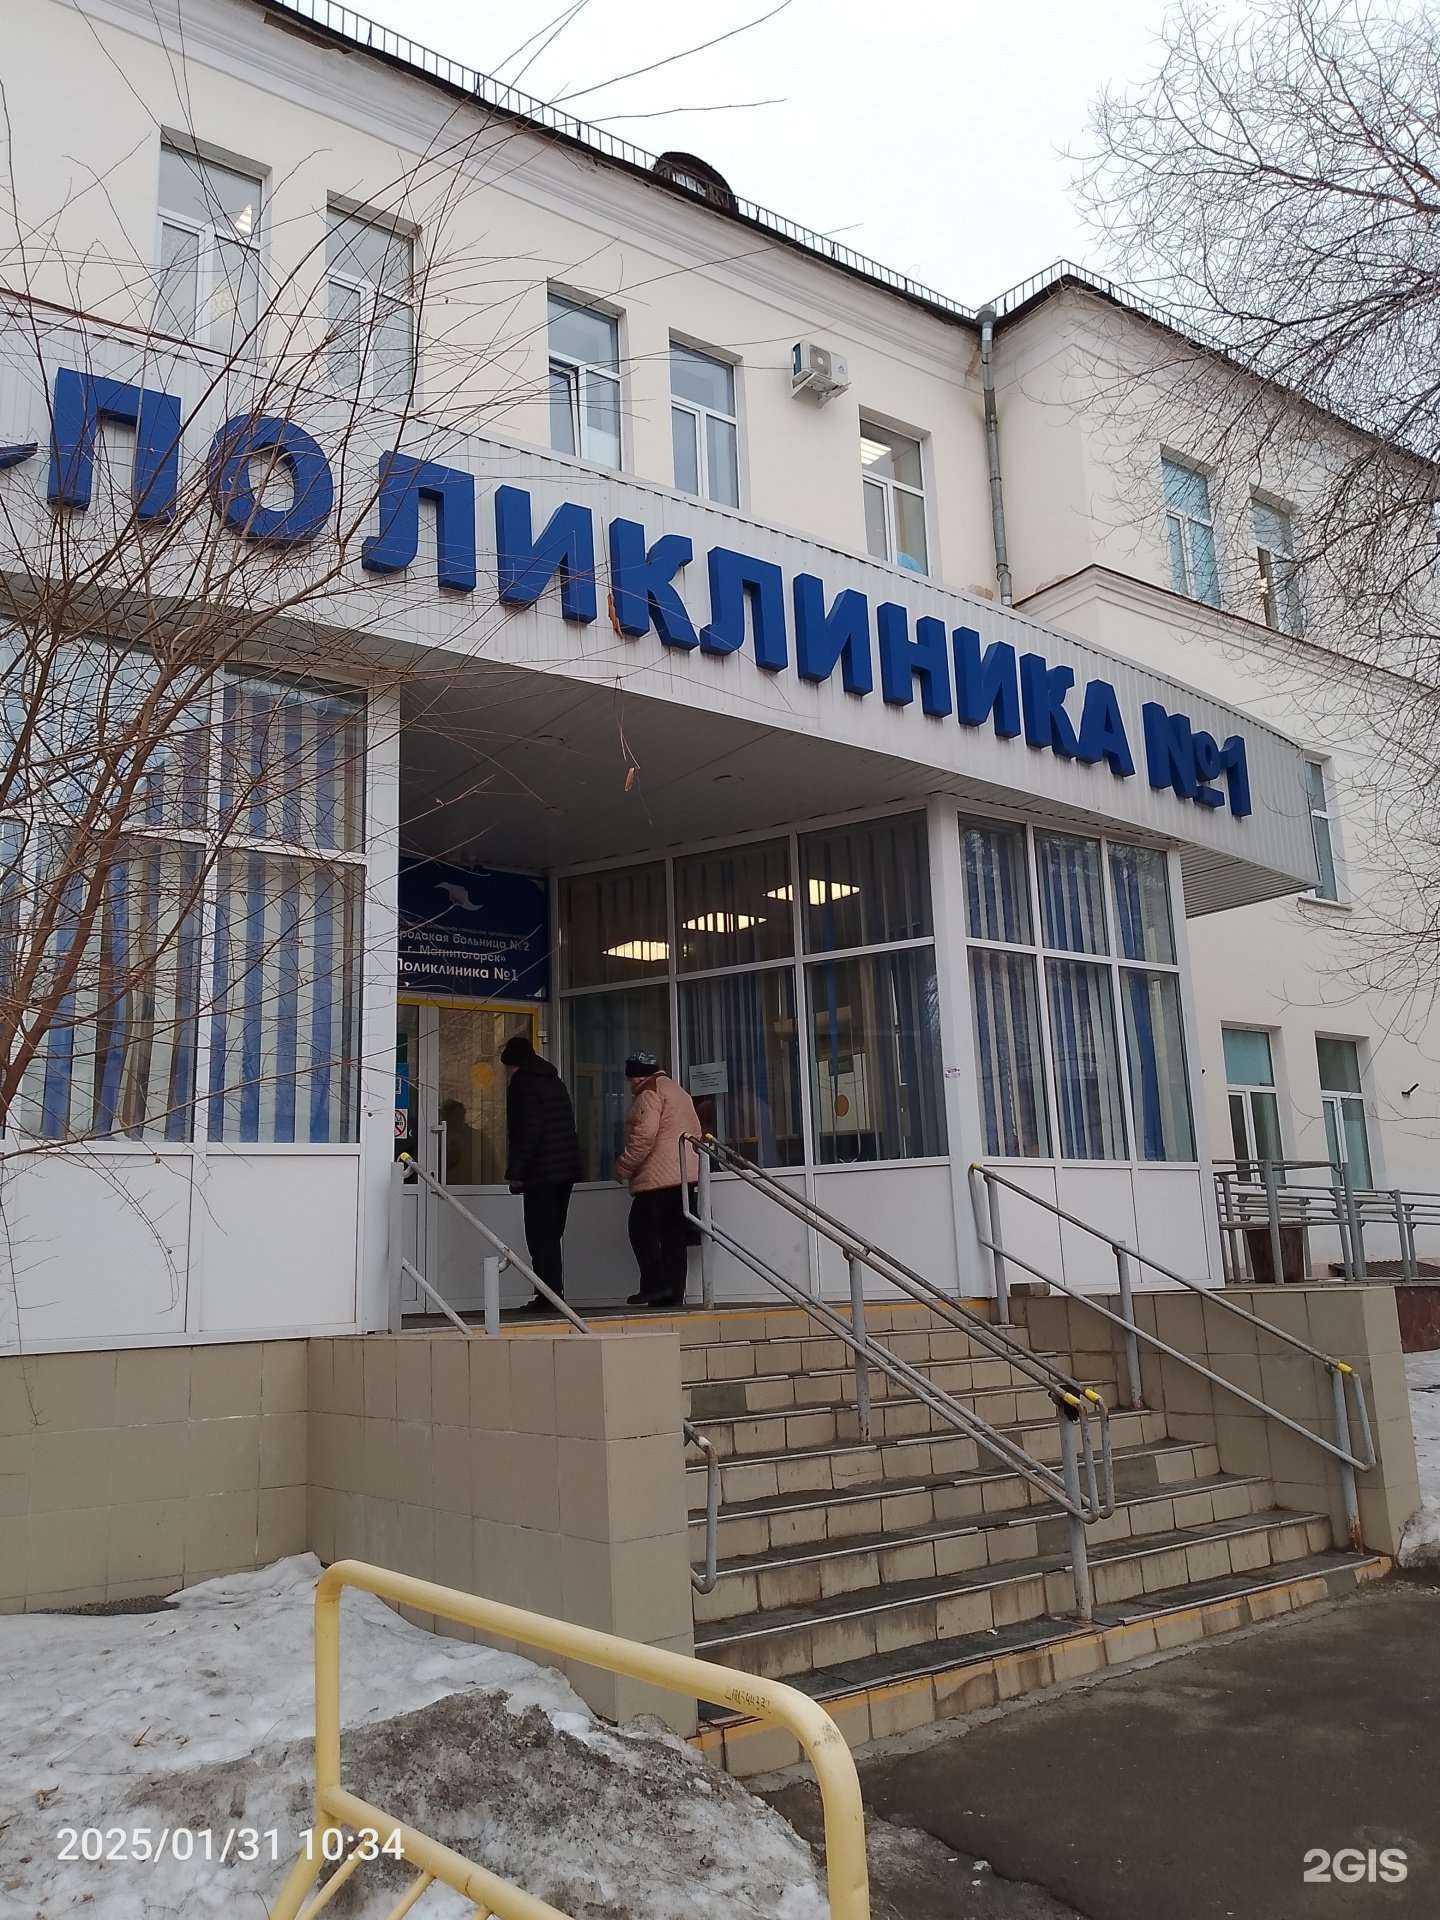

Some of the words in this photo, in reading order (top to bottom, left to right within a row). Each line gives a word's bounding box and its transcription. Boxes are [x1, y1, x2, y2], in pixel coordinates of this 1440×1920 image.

[47, 366, 1136, 778] ПОЛИКЛИНИКА
[1142, 701, 1252, 818] №1
[398, 930, 449, 943] родская
